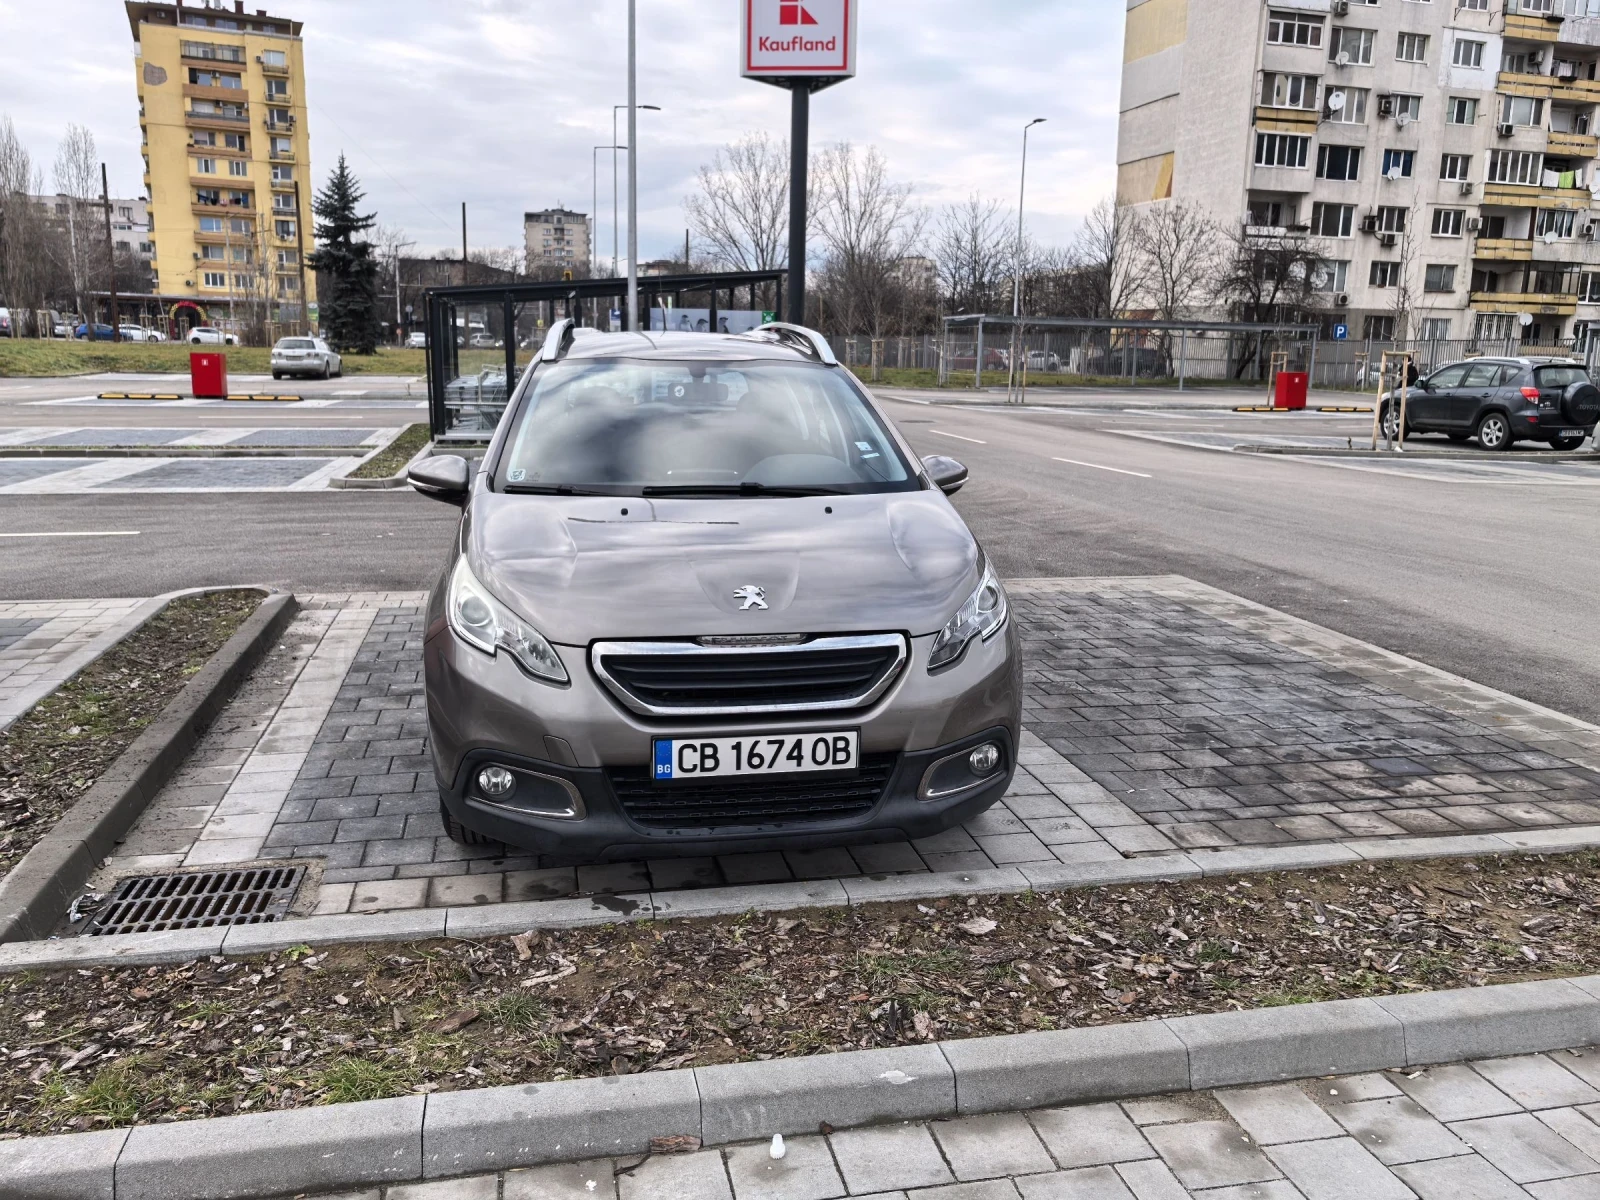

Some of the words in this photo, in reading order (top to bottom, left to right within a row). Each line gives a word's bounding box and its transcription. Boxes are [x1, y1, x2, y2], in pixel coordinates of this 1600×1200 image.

[758, 36, 836, 52] Kaufland
[1336, 326, 1345, 338] P
[677, 743, 720, 773] CB
[731, 738, 804, 771] 1674
[657, 764, 671, 774] BG
